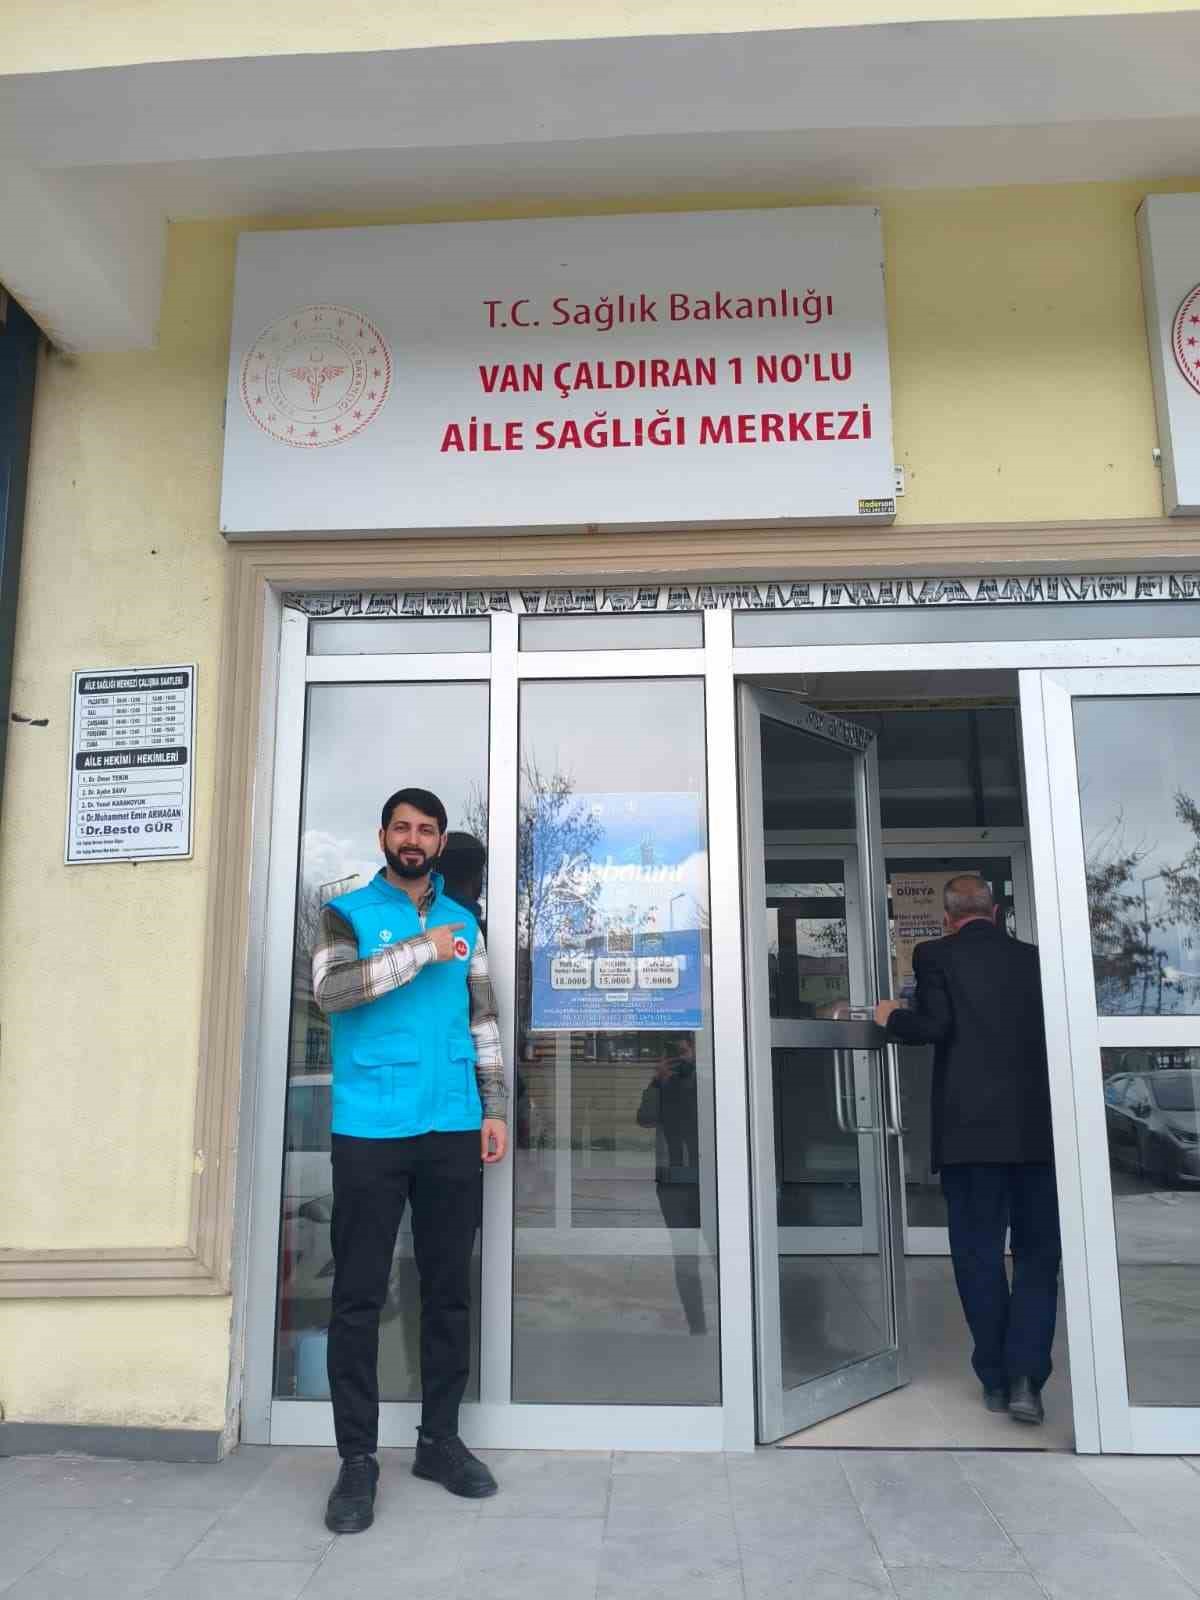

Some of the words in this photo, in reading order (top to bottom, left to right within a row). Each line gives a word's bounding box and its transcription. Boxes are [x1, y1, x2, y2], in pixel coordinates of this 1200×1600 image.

[484, 300, 540, 328] T.C.
[553, 294, 656, 330] Sağlık
[668, 288, 834, 324] Bakanlığı
[479, 360, 545, 395] VAN
[552, 355, 718, 401] ÇALDIRAN
[728, 356, 743, 385] 1
[755, 351, 854, 385] NO'LU
[440, 415, 523, 455] AİLE
[534, 409, 687, 451] SAĞLIĞI
[698, 403, 874, 448] MERKEZİ
[84, 756, 102, 767] AİLE
[103, 753, 131, 766] HEKİMİ
[137, 751, 178, 764] HEKİMLERİ
[131, 810, 147, 820] Emin
[144, 821, 173, 833] GÜR
[896, 886, 935, 896] DÜNYA
